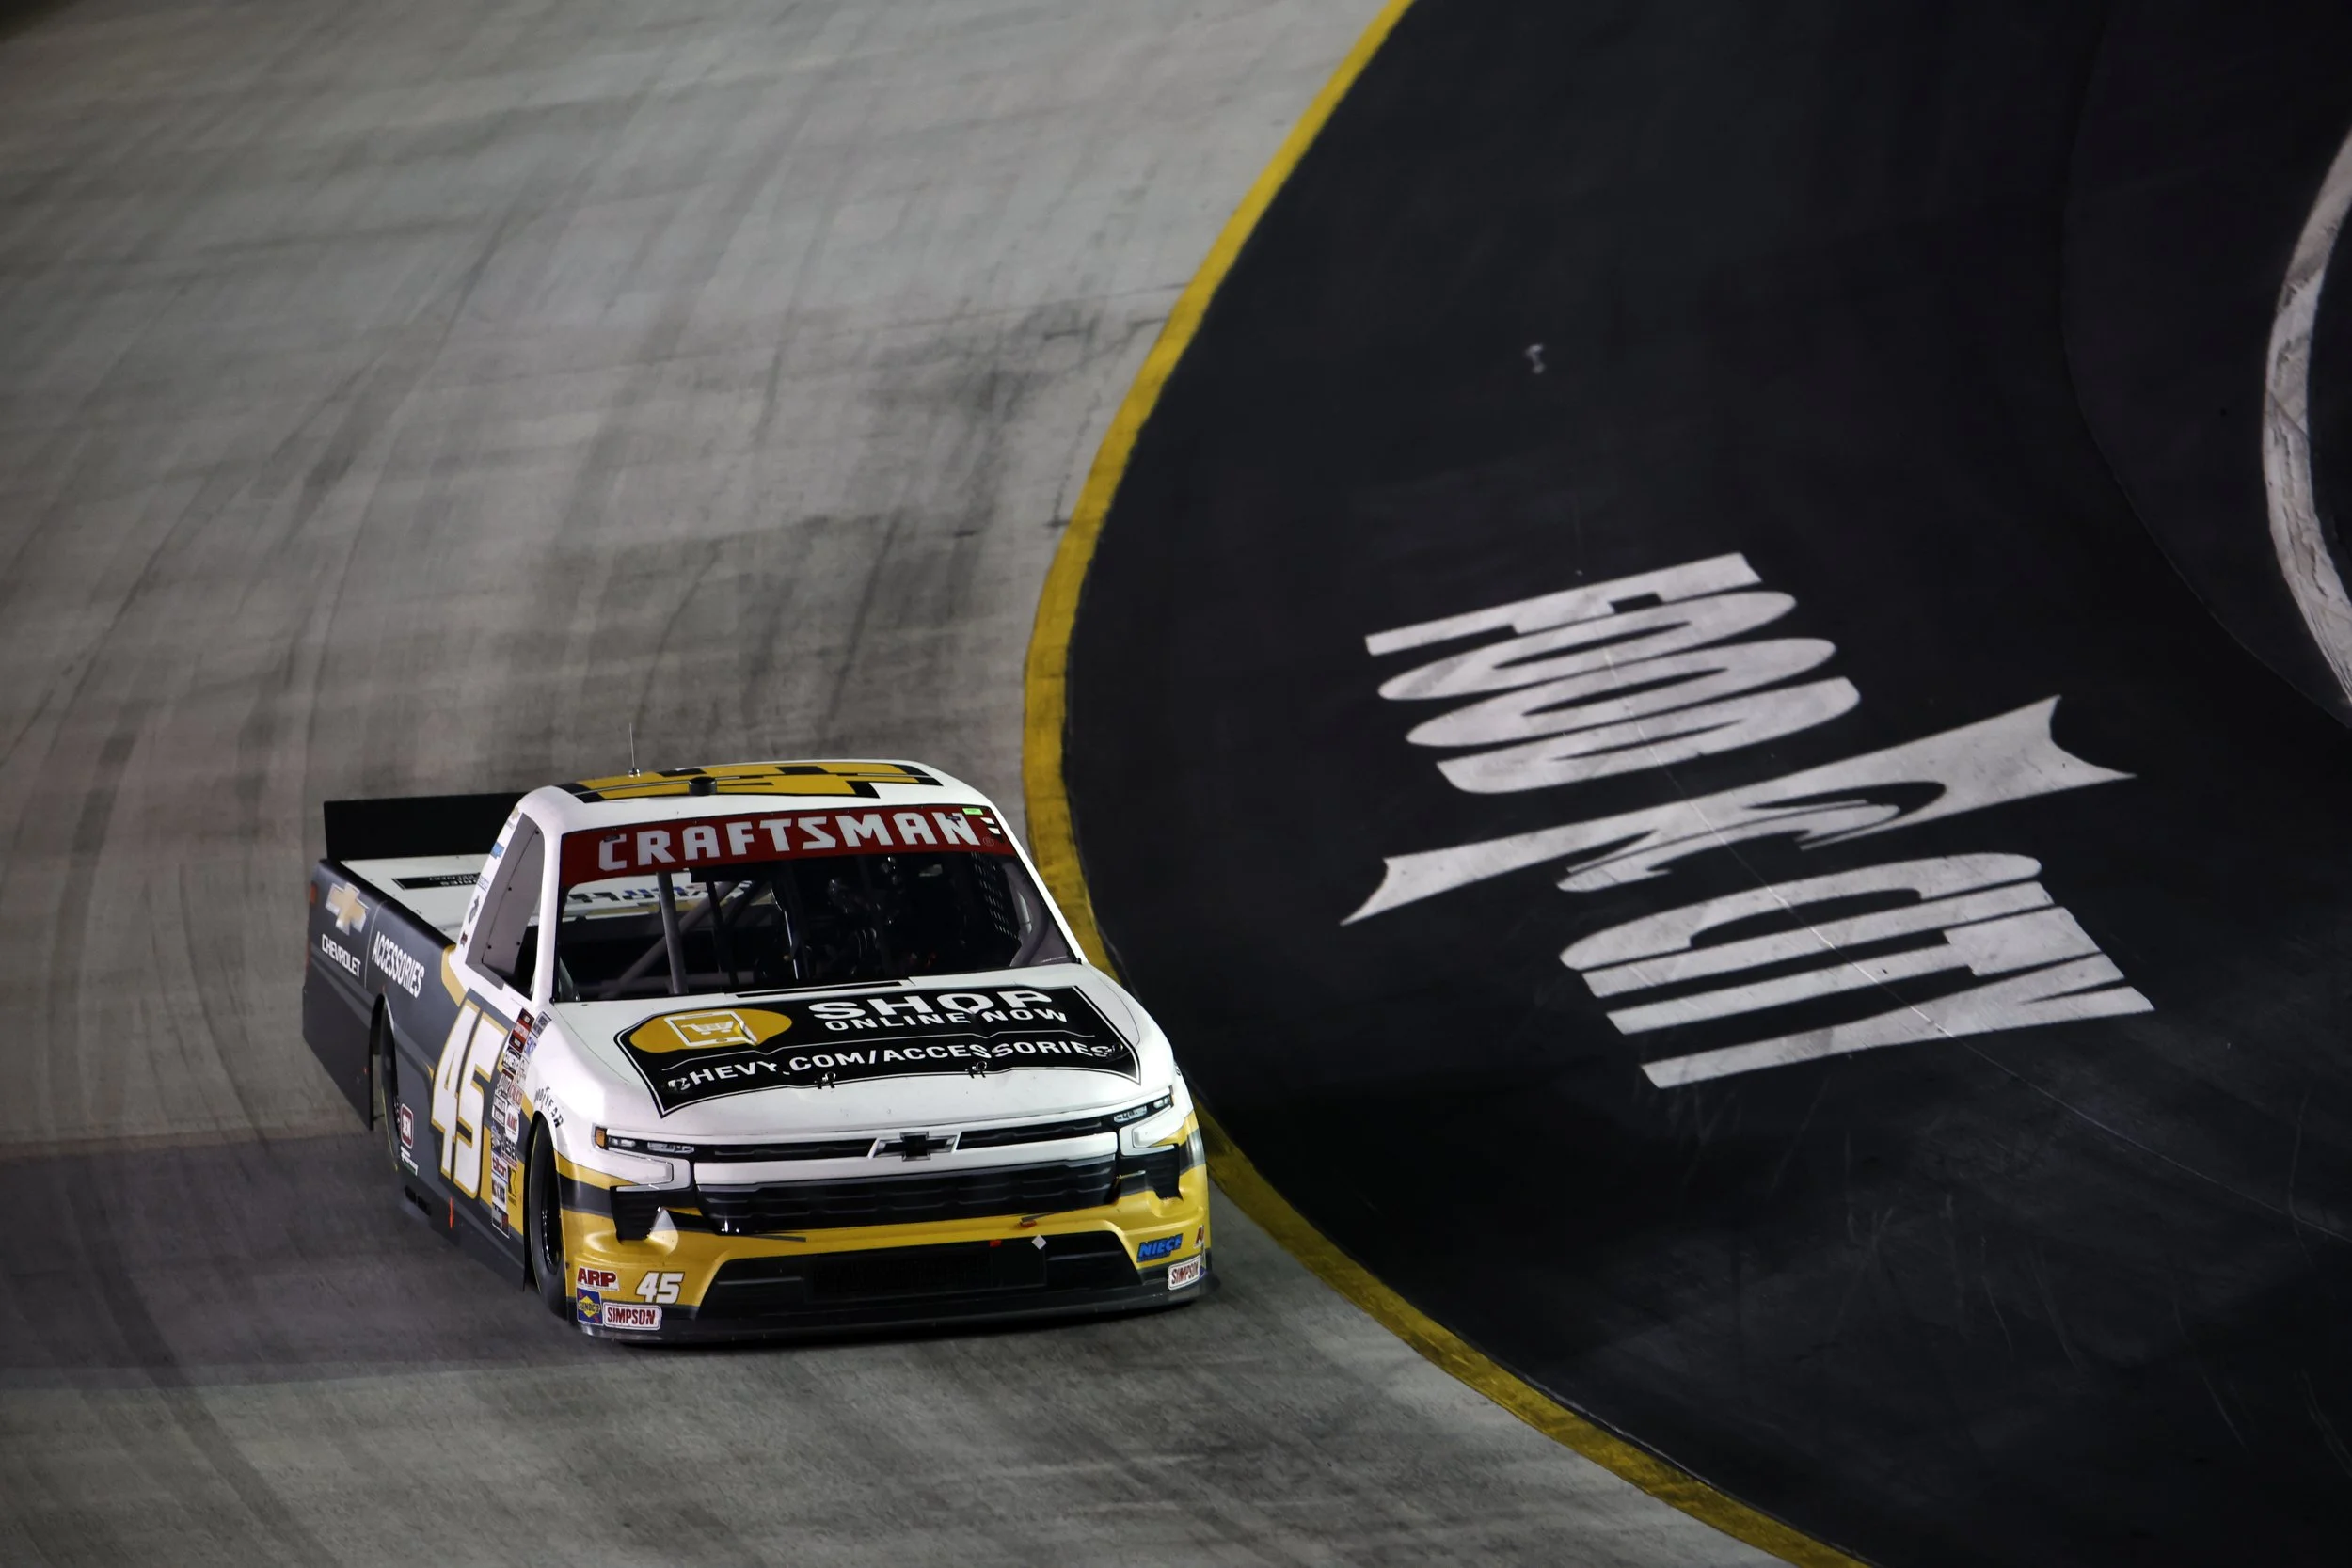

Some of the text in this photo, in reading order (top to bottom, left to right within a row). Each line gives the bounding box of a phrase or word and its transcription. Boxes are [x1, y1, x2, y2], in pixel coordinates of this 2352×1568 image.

[1365, 551, 2155, 1089] FOOD CITY
[597, 811, 981, 871] CRAFTSMAN
[321, 933, 361, 977] CHEVROLET
[372, 930, 425, 999] ACCESSORIES
[808, 990, 1053, 1021] SHOP
[824, 1007, 1068, 1032] ONLINE NOW
[430, 998, 509, 1200] 45
[577, 1267, 616, 1287] ARP
[635, 1271, 685, 1304] 45
[1171, 1261, 1199, 1285] SIMPSON
[578, 1301, 600, 1314] SUNOCO
[607, 1307, 656, 1325] SIMPSON
